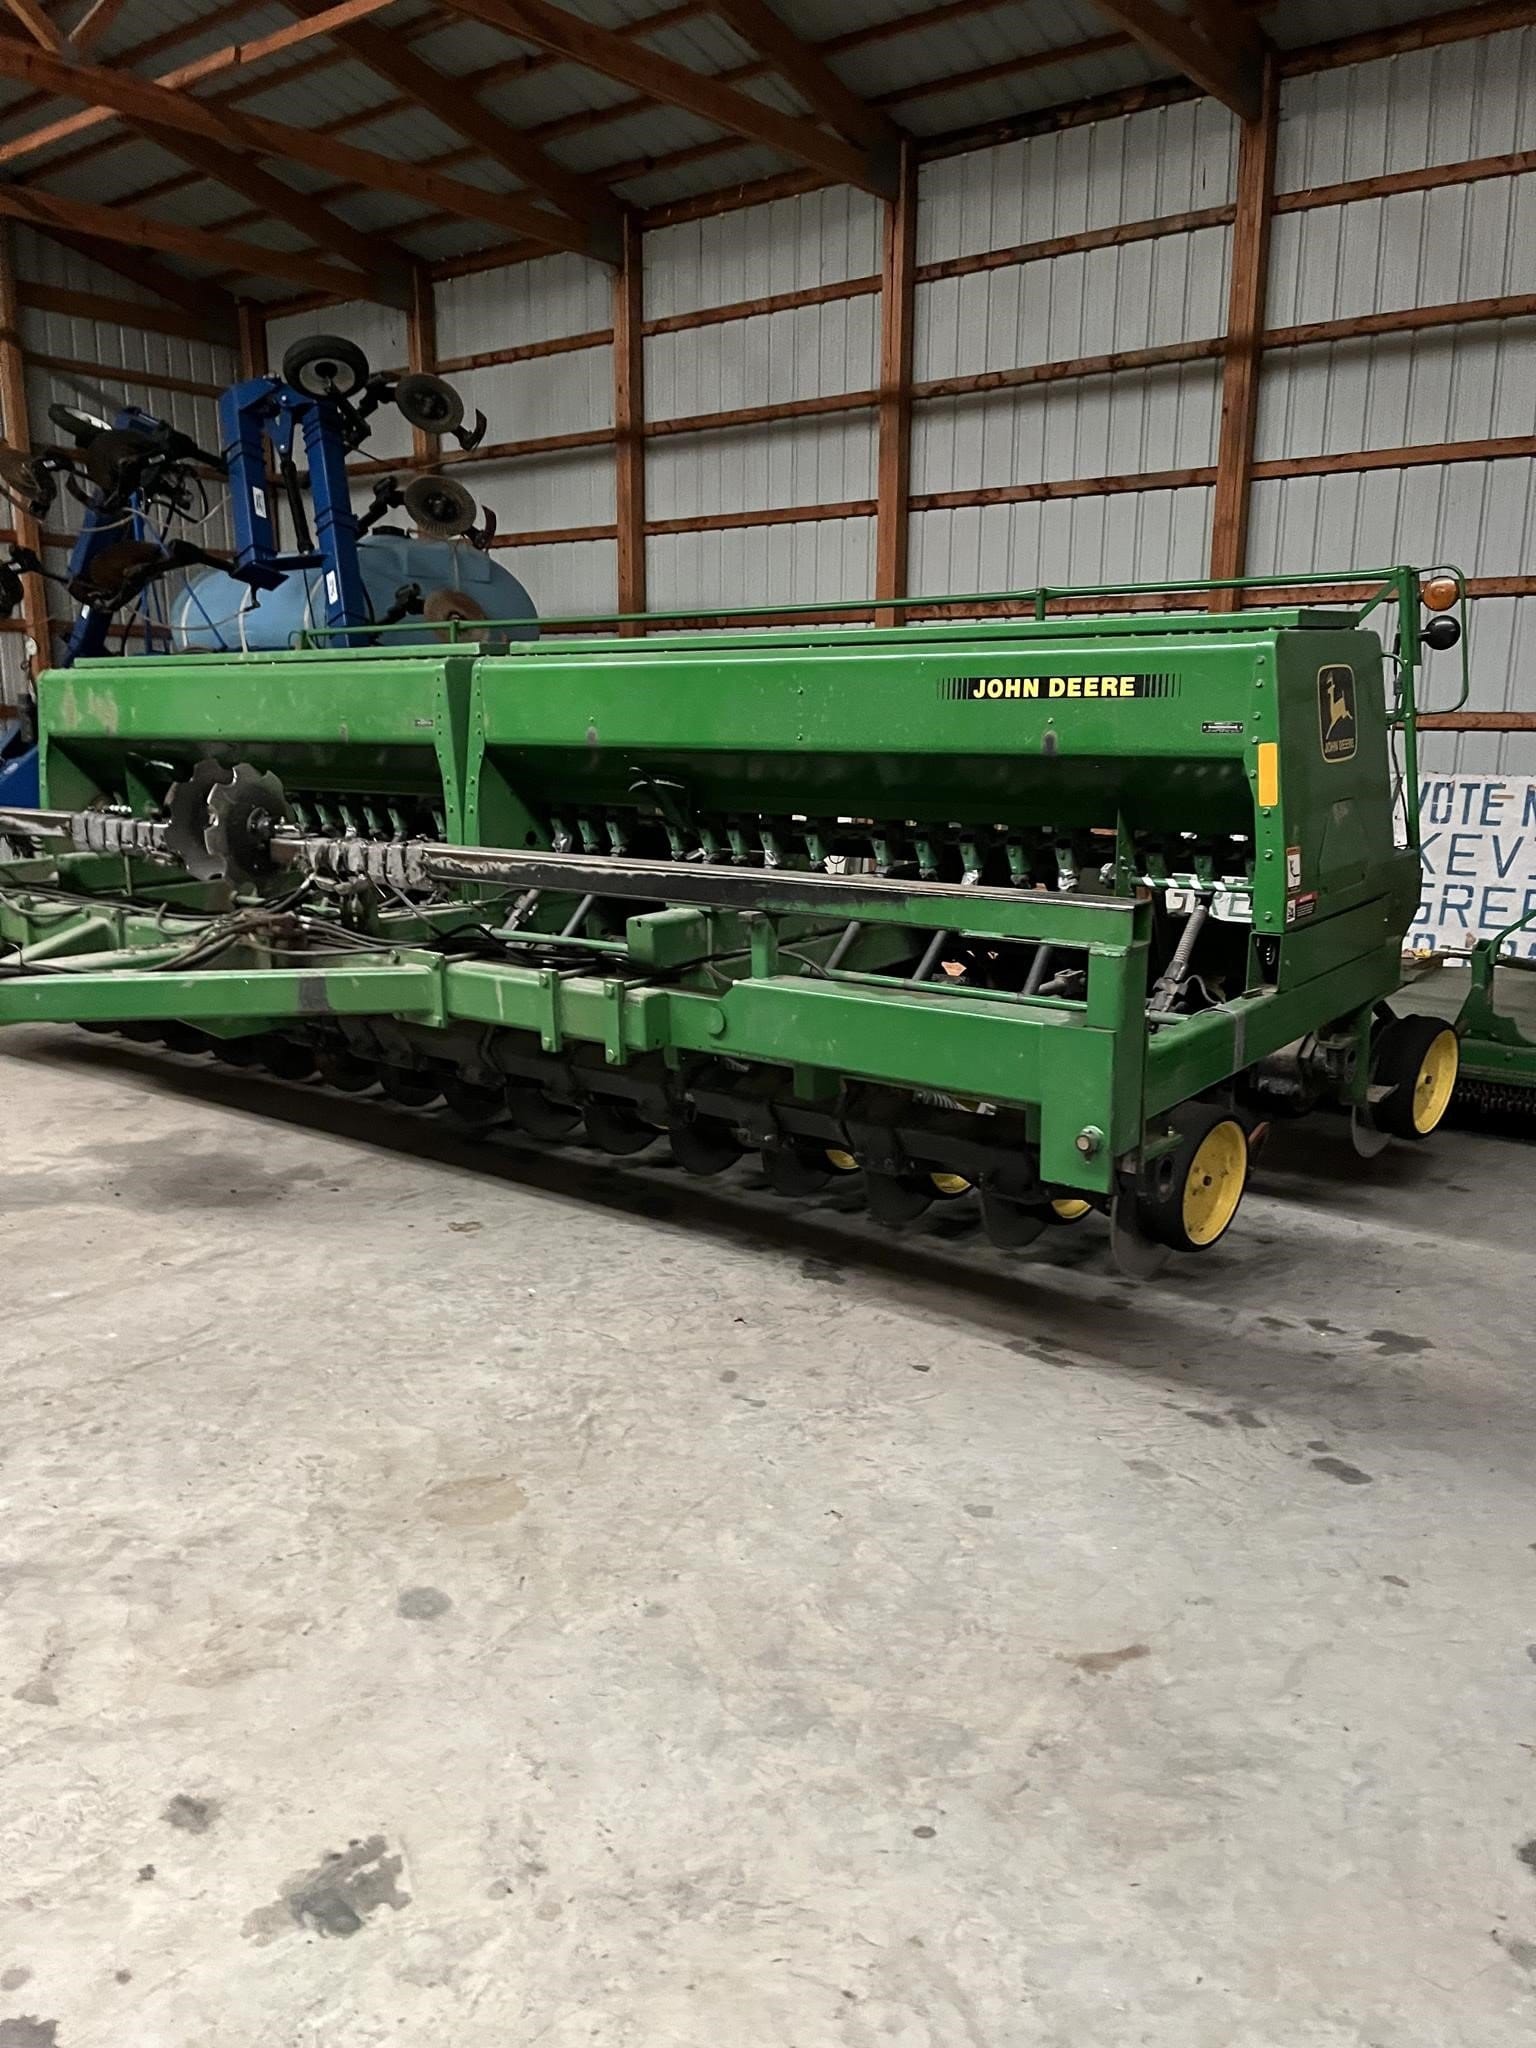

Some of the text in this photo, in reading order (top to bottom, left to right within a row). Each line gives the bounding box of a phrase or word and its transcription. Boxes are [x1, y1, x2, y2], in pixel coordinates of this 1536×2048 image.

[973, 676, 1136, 698] JOHN DEERE
[1420, 832, 1536, 879] KEV
